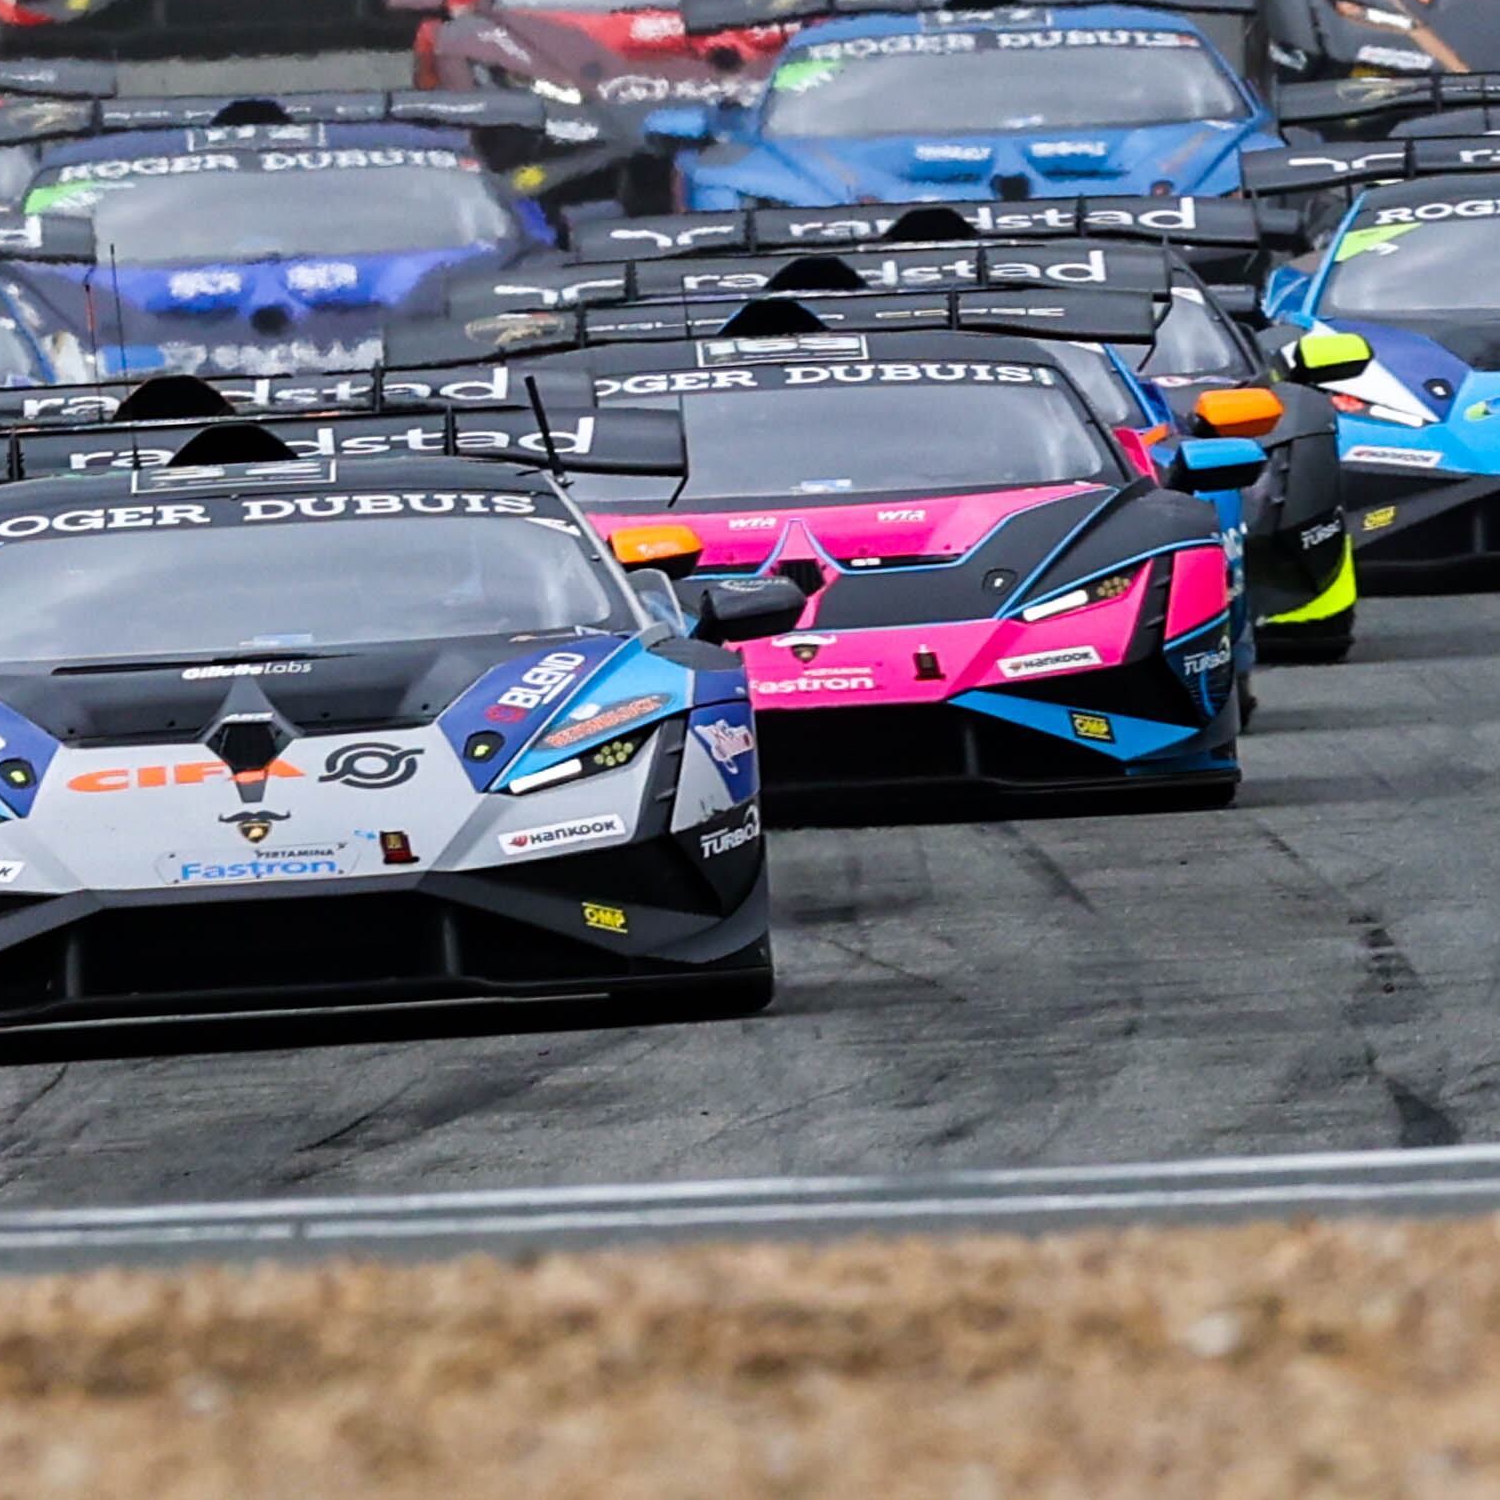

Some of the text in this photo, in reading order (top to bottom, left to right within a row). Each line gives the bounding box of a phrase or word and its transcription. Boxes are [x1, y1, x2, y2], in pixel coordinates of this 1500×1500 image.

[784, 362, 1035, 386] DUBUIS
[242, 492, 537, 522] DUBUIS
[877, 509, 927, 522] WTR
[728, 516, 777, 530] WTR
[497, 651, 586, 709] BLEND
[181, 860, 338, 881] Fastron
